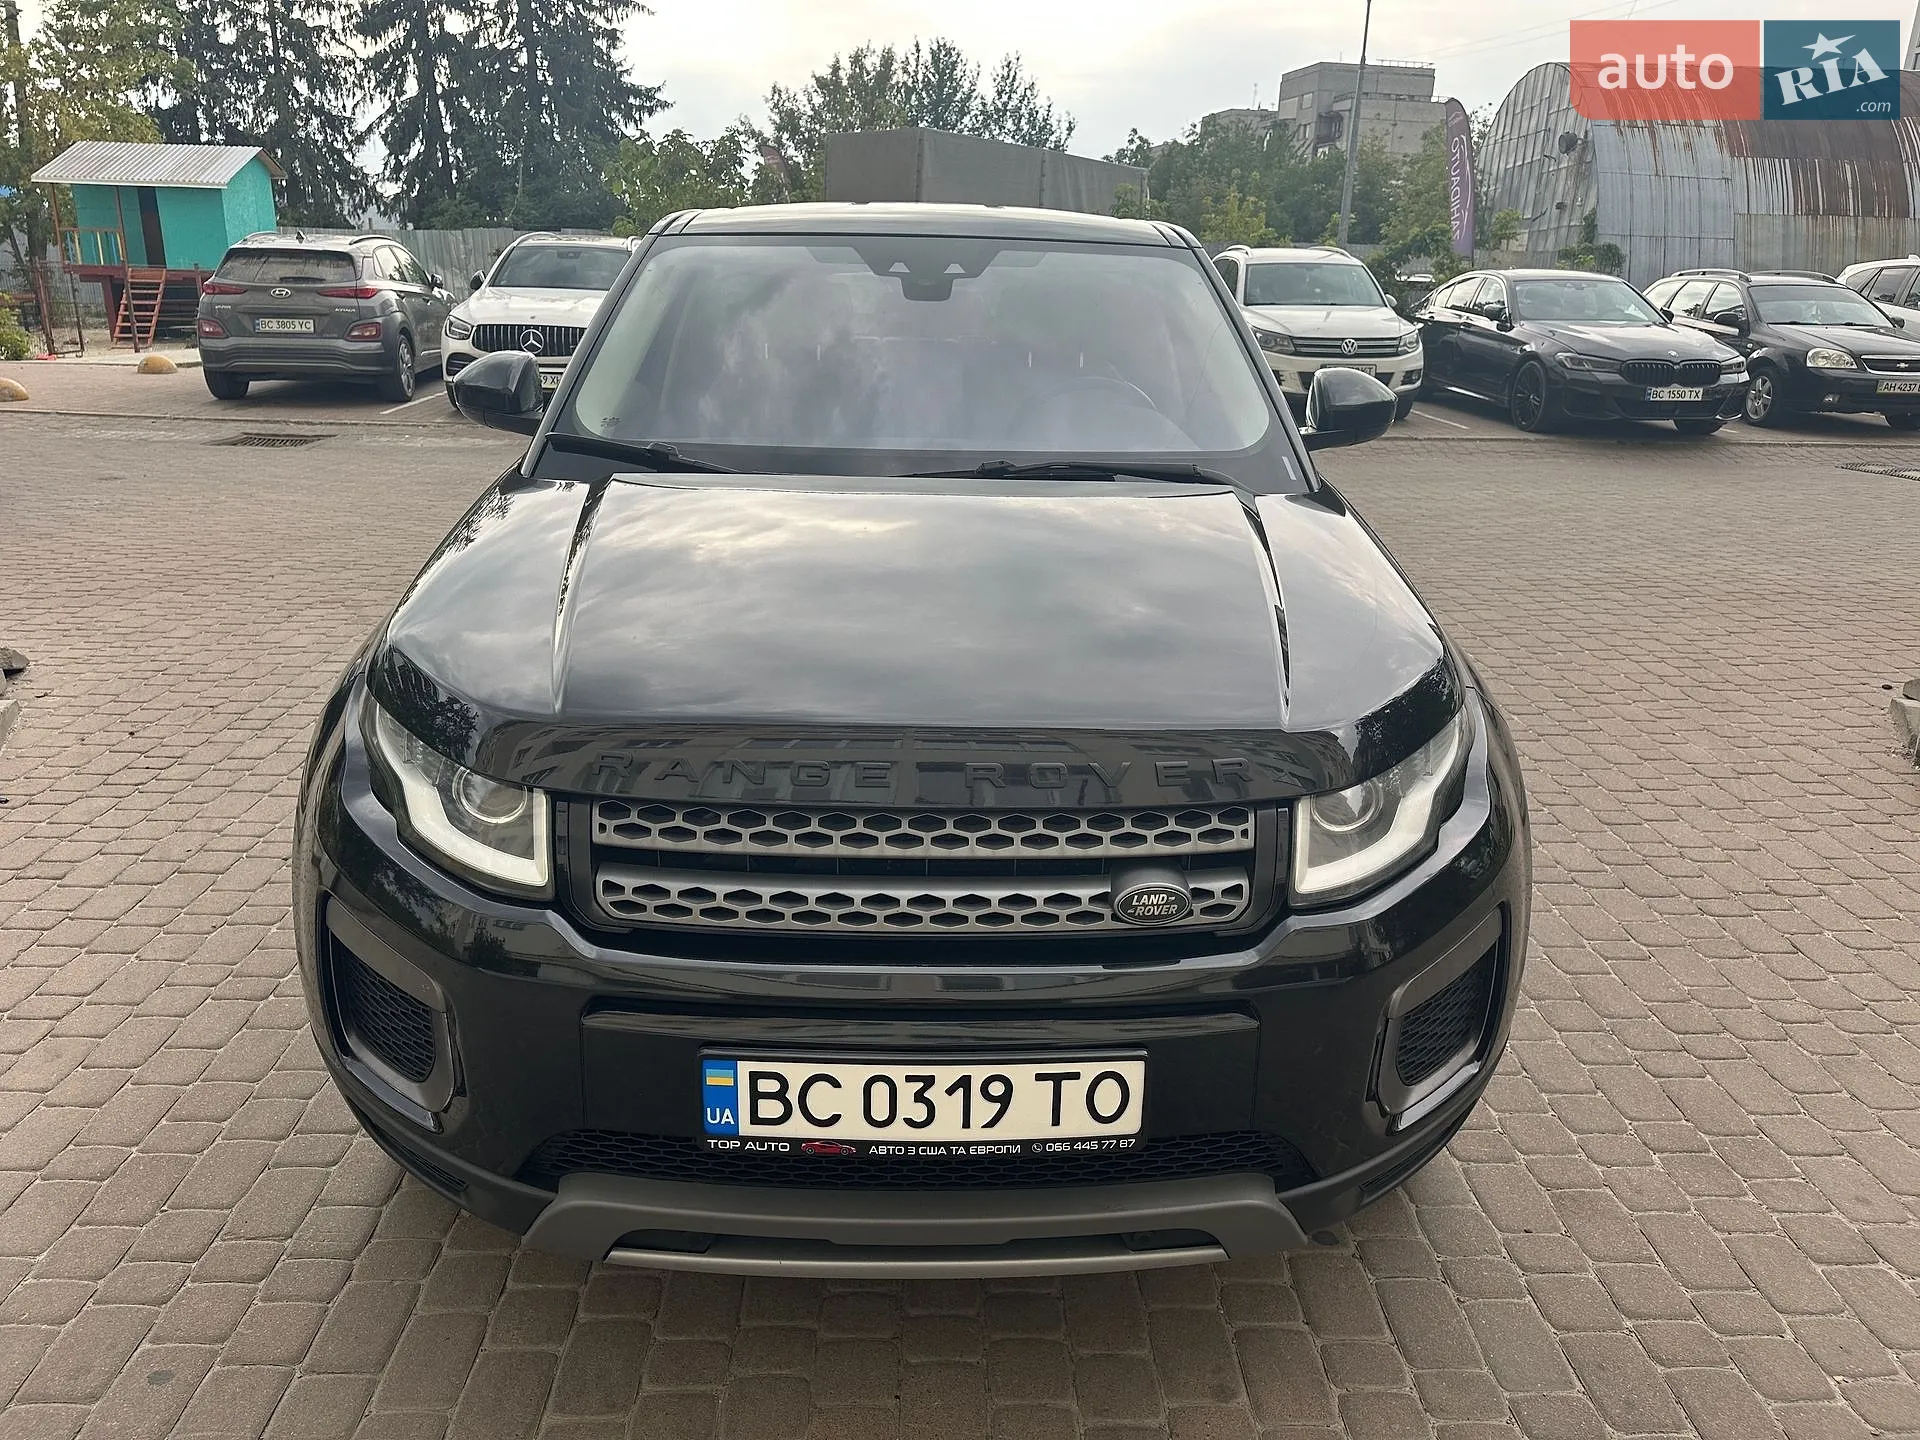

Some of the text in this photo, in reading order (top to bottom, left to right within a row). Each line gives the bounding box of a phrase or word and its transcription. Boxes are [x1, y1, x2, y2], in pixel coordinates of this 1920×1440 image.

[260, 320, 274, 329] BC
[275, 320, 297, 330] 3805
[1882, 382, 1897, 392] AH
[1897, 383, 1917, 392] 4237
[1651, 390, 1701, 400] BC 1550 TX
[591, 750, 1253, 789] RANGE ROVER
[748, 1070, 1131, 1129] BC 0319 TO
[706, 1107, 735, 1125] UA
[706, 1139, 791, 1152] TOP AUTO
[868, 1145, 905, 1156] АВТО
[918, 1146, 947, 1156] США
[950, 1146, 967, 1156] ТА
[969, 1144, 1021, 1155] ЄВРОПИ
[1045, 1138, 1136, 1152] 066 445 77 87
